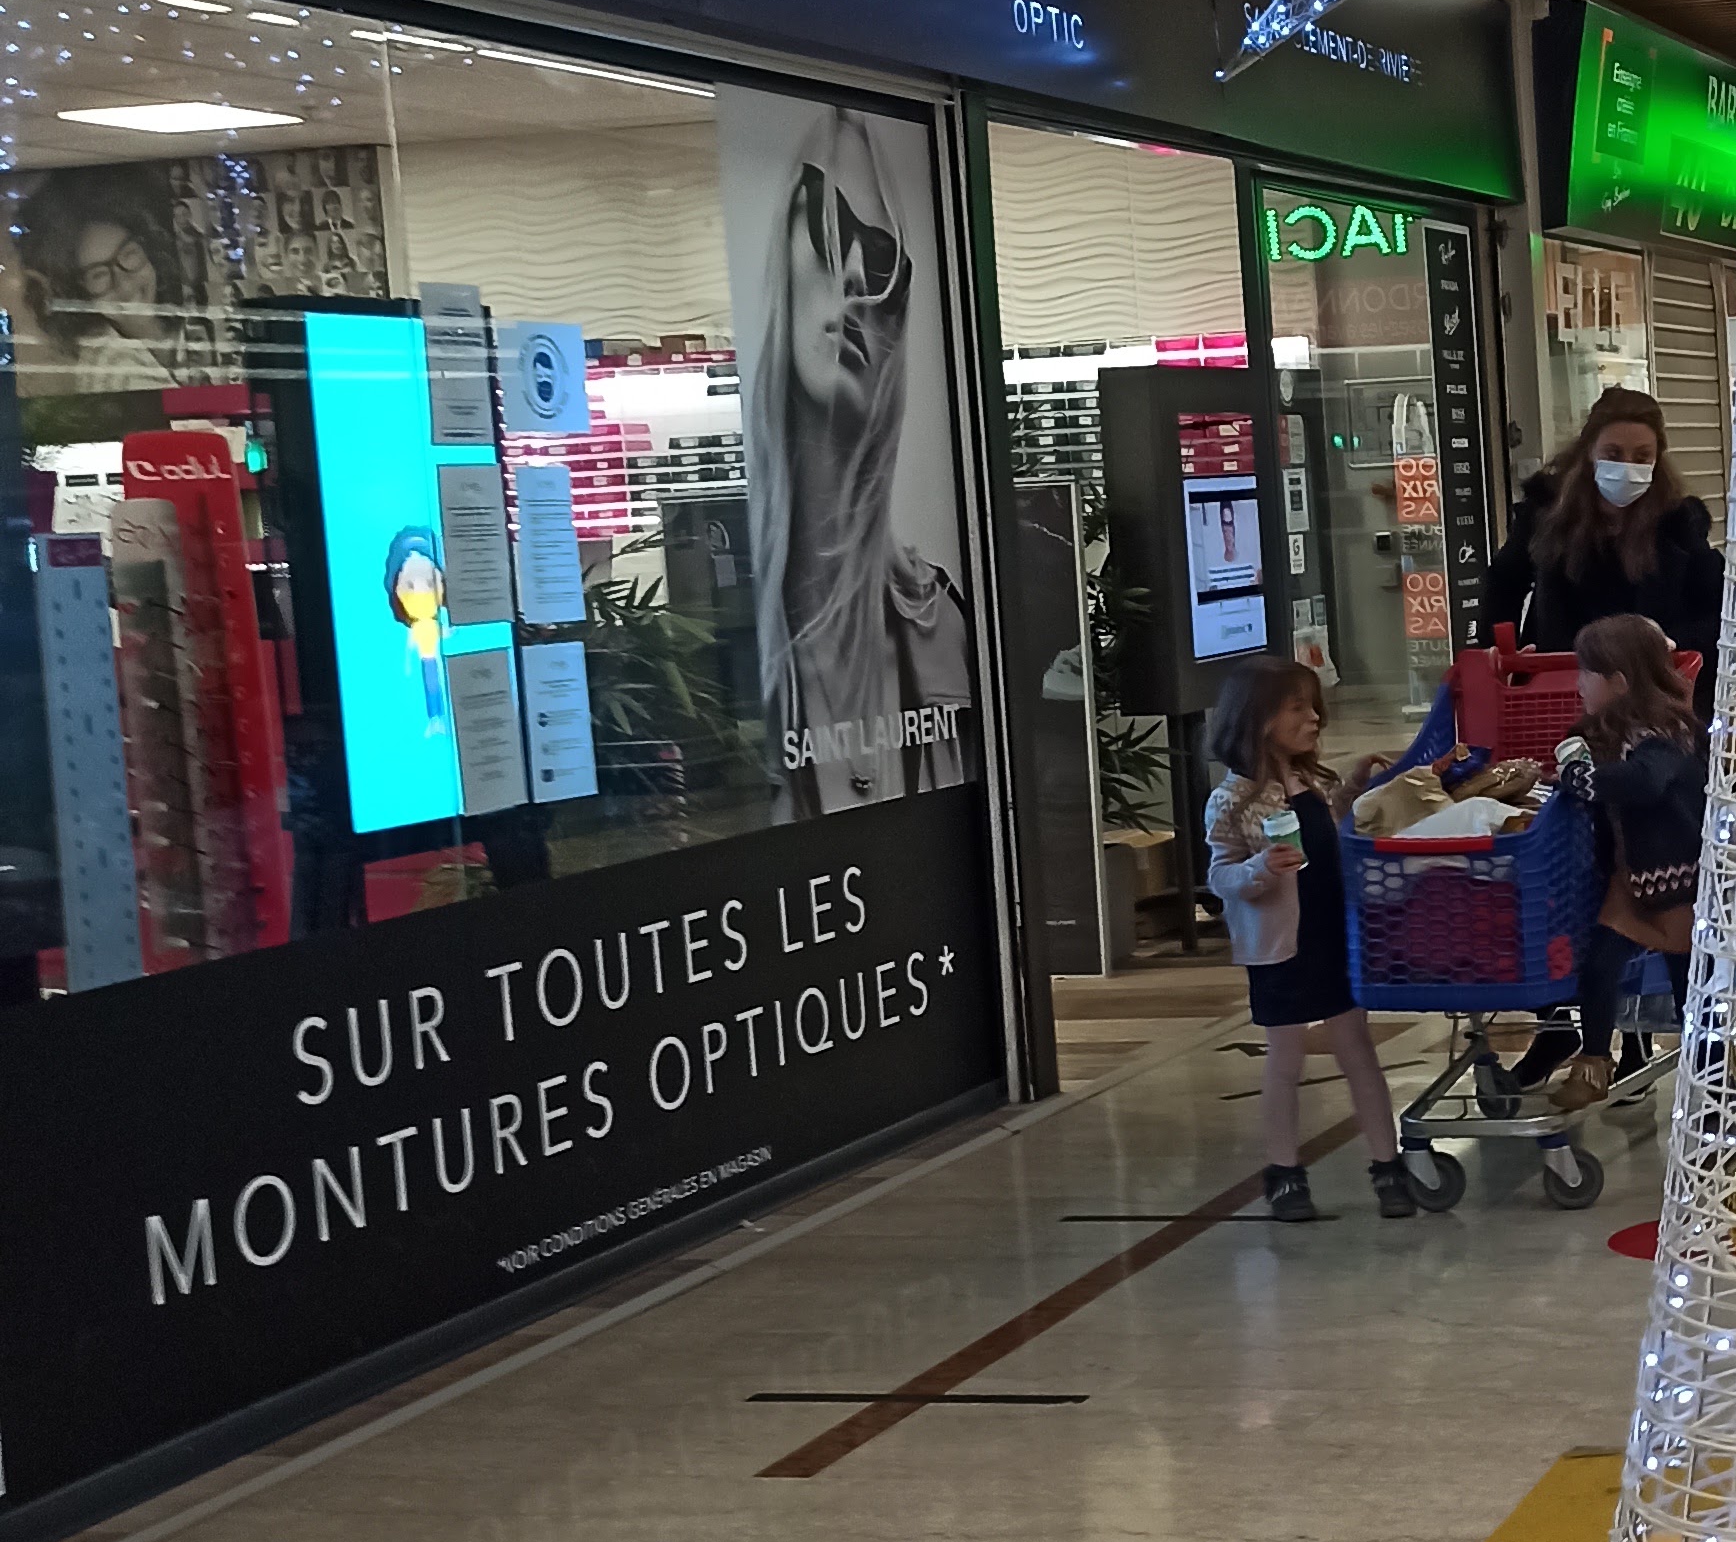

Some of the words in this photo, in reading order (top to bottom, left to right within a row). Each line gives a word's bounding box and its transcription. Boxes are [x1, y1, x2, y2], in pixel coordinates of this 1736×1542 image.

[782, 720, 853, 771] SAINT
[859, 702, 960, 762] LAURENT
[292, 984, 451, 1106] SUR
[485, 898, 747, 1043] TOUTES
[776, 865, 867, 954] LES
[144, 1060, 615, 1306] MONTURES
[539, 1206, 627, 1257] CONDITIONS
